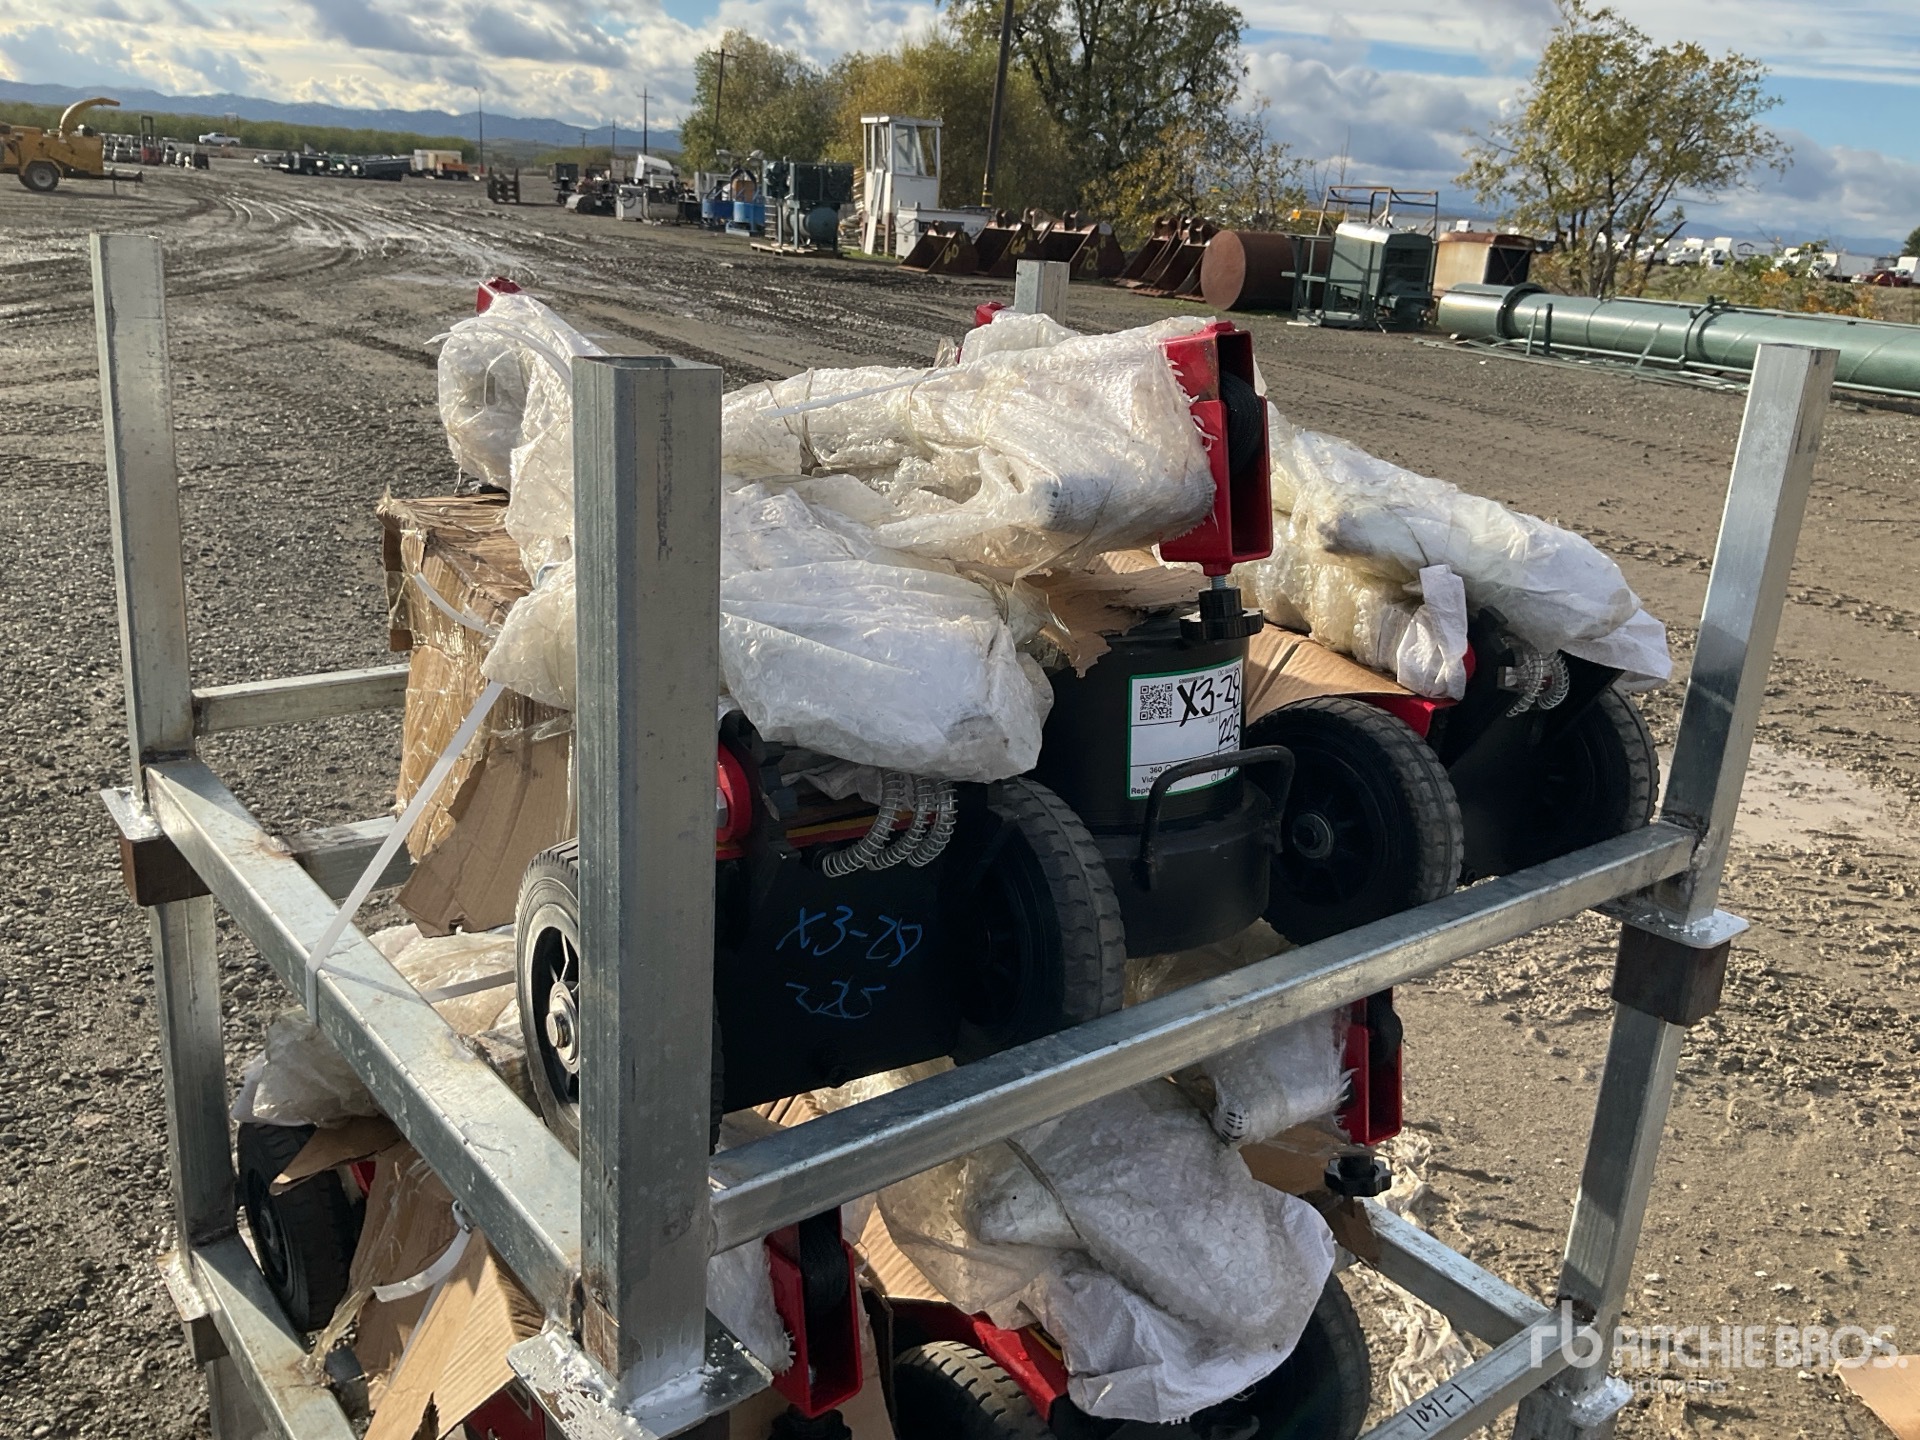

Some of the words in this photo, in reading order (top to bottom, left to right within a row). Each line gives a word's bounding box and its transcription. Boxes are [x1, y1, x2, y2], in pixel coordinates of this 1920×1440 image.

[1176, 667, 1241, 728] X3-28
[1218, 712, 1240, 746] 225
[1141, 776, 1158, 784] Vide
